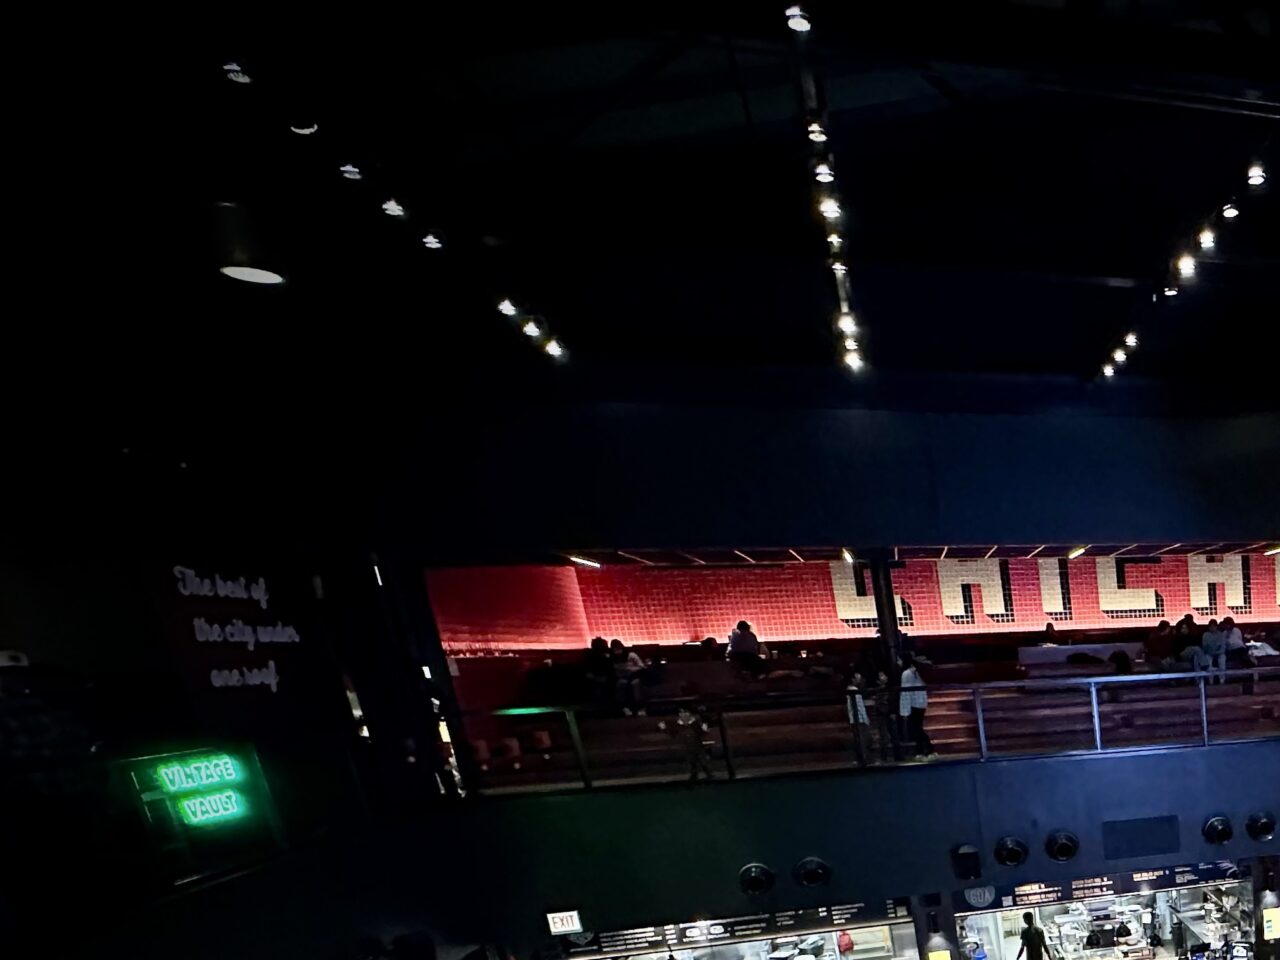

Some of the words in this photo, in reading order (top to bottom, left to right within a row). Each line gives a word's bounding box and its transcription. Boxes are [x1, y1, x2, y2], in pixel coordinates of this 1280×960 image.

[161, 758, 236, 790] VINTAGE
[184, 791, 238, 822] VAULT
[552, 914, 575, 929] EXIT
